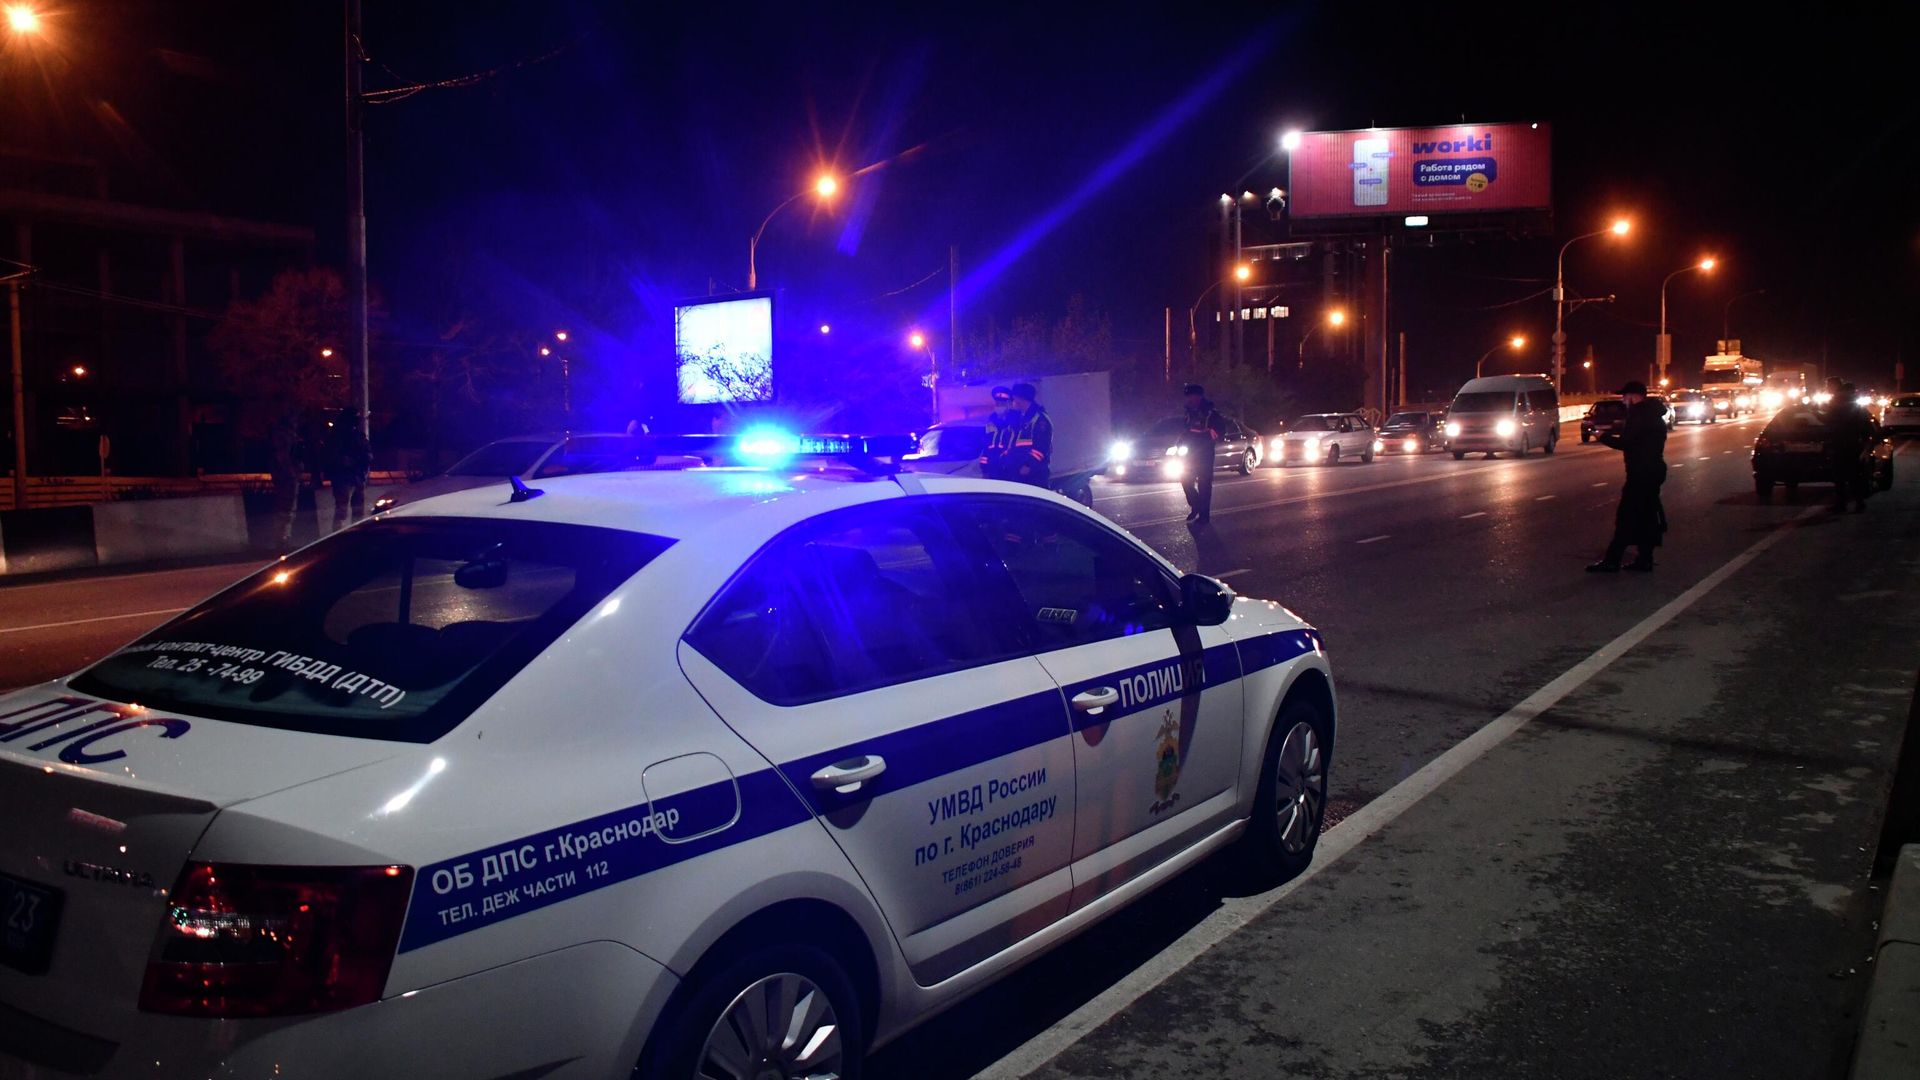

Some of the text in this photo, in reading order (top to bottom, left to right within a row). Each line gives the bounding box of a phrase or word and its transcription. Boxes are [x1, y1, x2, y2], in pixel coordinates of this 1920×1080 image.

[1413, 133, 1492, 154] worki
[1420, 163, 1486, 173] Работа рядом
[1428, 174, 1461, 182] домом
[176, 658, 209, 672] 25
[262, 650, 343, 683] ГИБДД
[331, 671, 407, 710] (ДТП)
[1119, 658, 1207, 709] ПОЛИЦИЯ
[0, 697, 191, 764] ДПС
[929, 768, 1047, 825] УМВД России
[432, 806, 680, 895] ОБ ДПС г.Краснодар
[915, 794, 1057, 866] по г. Краснодару
[943, 835, 1035, 884] ТЕЛЕФОН ДОВЕРИЯ
[7, 890, 42, 933] 23
[437, 860, 610, 926] ТЕЛ. ДЕЖ ЧАСТИ 112
